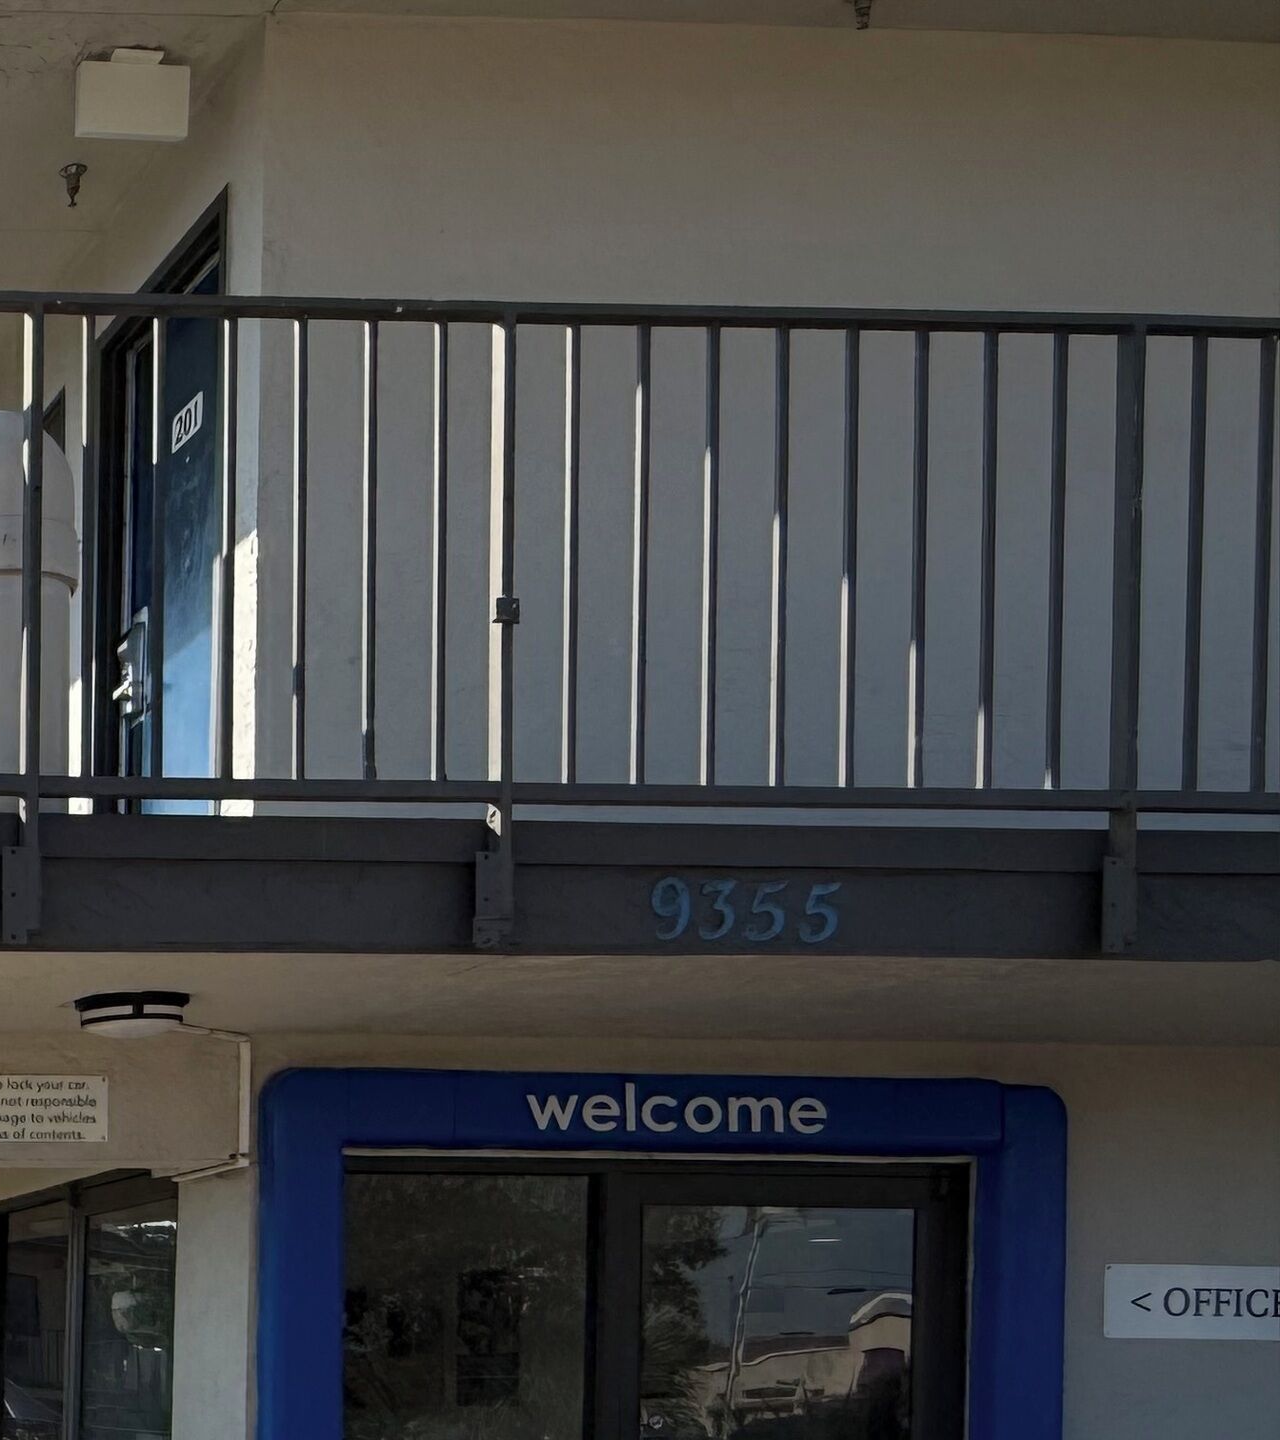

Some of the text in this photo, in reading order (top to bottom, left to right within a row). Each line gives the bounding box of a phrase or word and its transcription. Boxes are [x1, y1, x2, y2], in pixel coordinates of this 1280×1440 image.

[174, 399, 198, 446] 201
[651, 876, 842, 944] 9355
[7, 1078, 33, 1090] lock
[36, 1079, 63, 1092] your
[1, 1096, 23, 1107] not
[25, 1095, 97, 1109] responsible
[526, 1082, 828, 1134] welcome
[31, 1113, 44, 1123] to
[47, 1111, 97, 1124] vehicles
[13, 1128, 26, 1140] of
